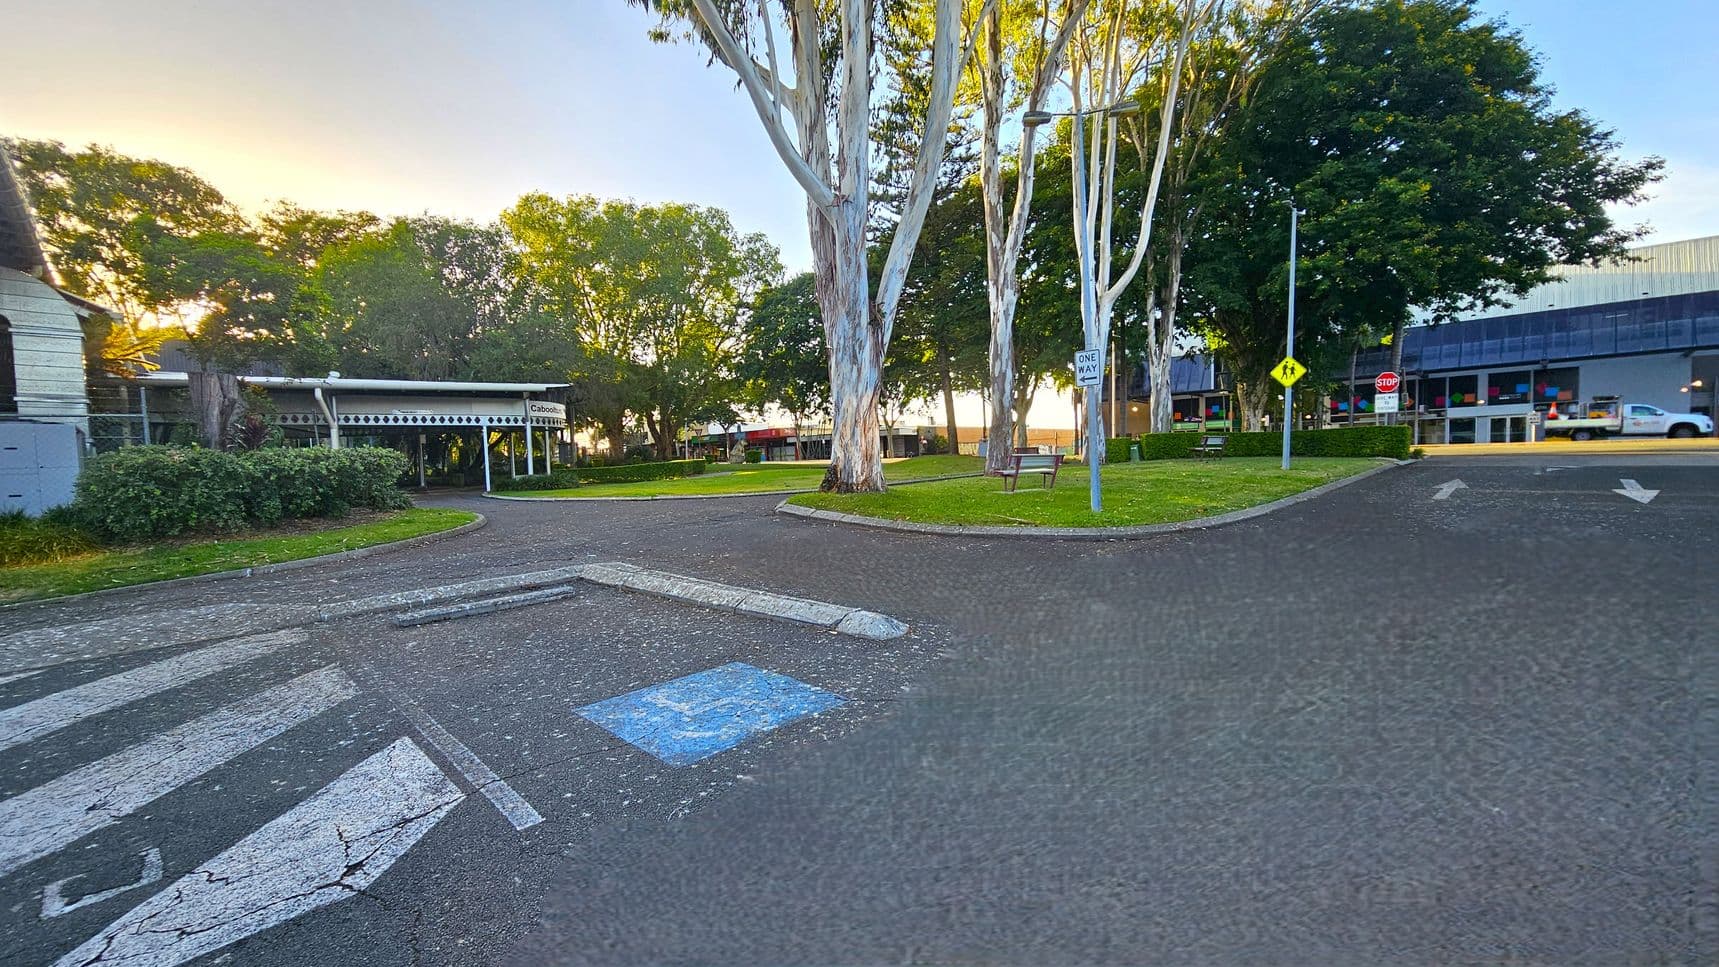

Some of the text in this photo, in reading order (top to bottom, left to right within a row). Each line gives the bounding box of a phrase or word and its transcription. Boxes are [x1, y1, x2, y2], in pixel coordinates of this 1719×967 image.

[1079, 353, 1096, 363] ONE
[1078, 364, 1097, 373] WAY
[1377, 378, 1397, 386] STOP
[530, 404, 561, 414] Caboo
